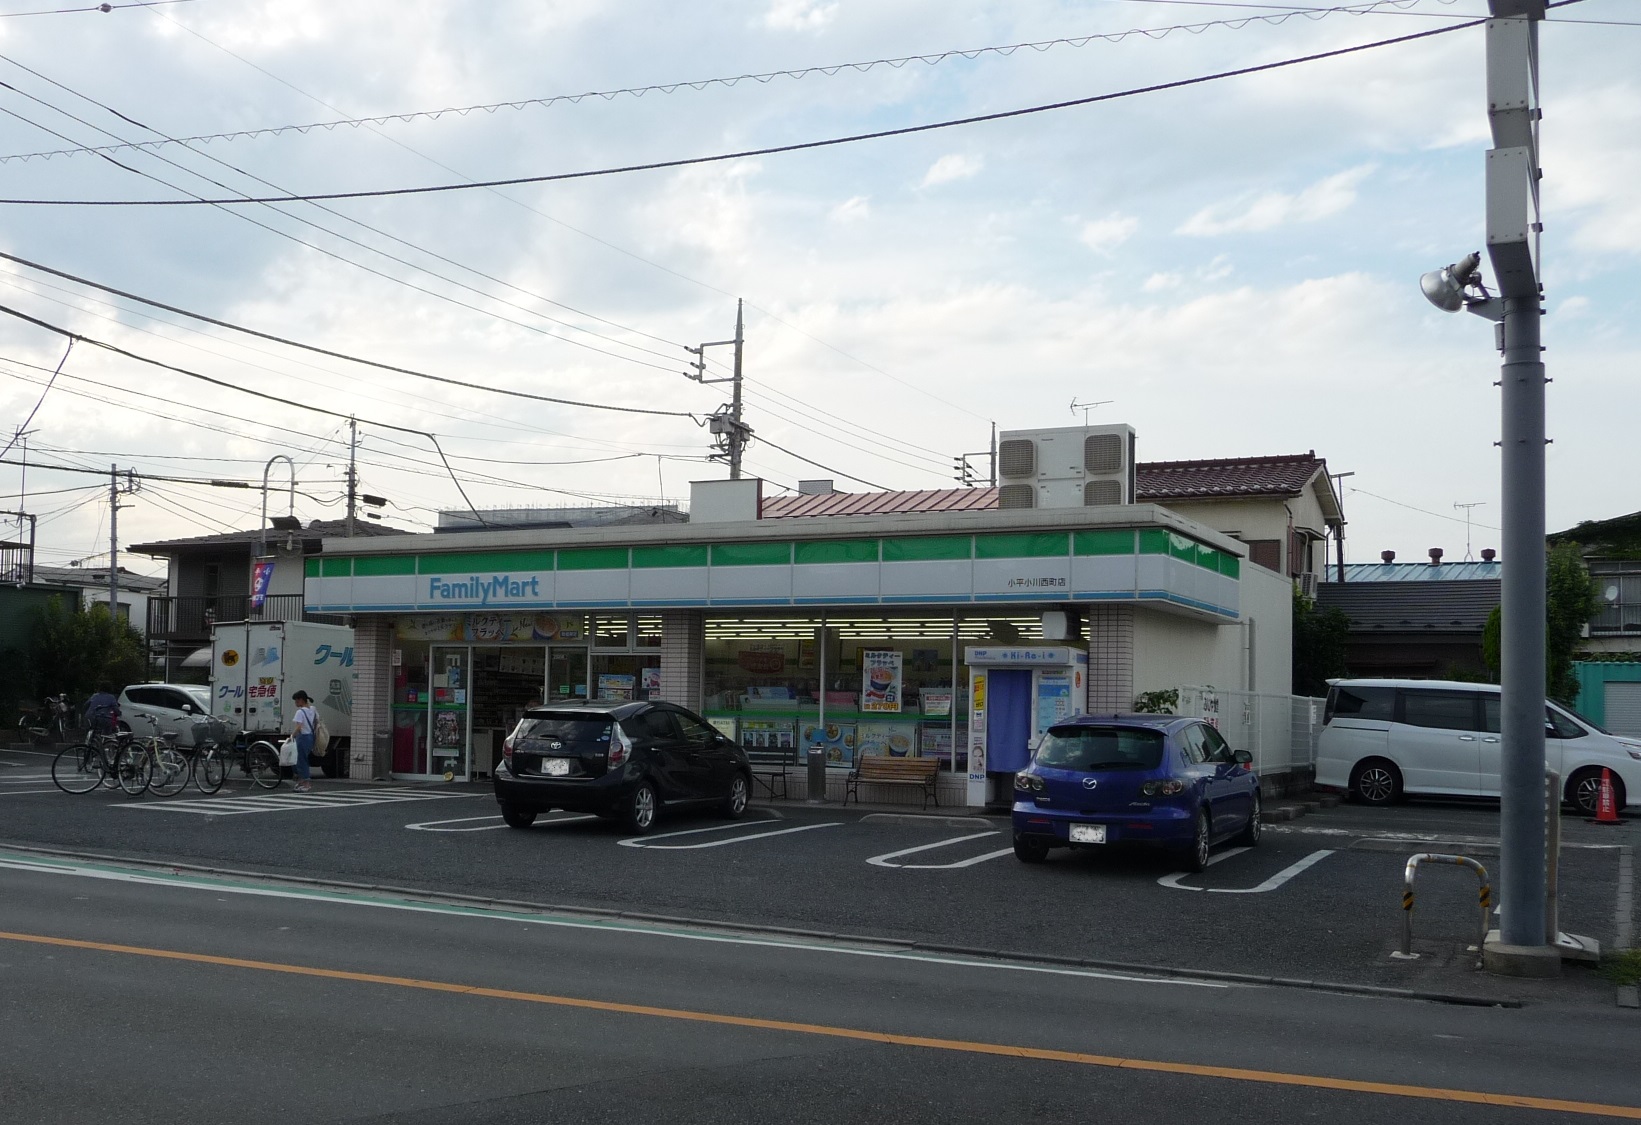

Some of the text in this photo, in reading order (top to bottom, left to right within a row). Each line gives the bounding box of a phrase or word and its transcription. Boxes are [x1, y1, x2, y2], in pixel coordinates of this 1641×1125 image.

[430, 576, 539, 604] FamilyMart
[1008, 578, 1066, 588] 小平小川西町店
[314, 644, 354, 667] クール
[219, 685, 277, 699] クール 宅急便
